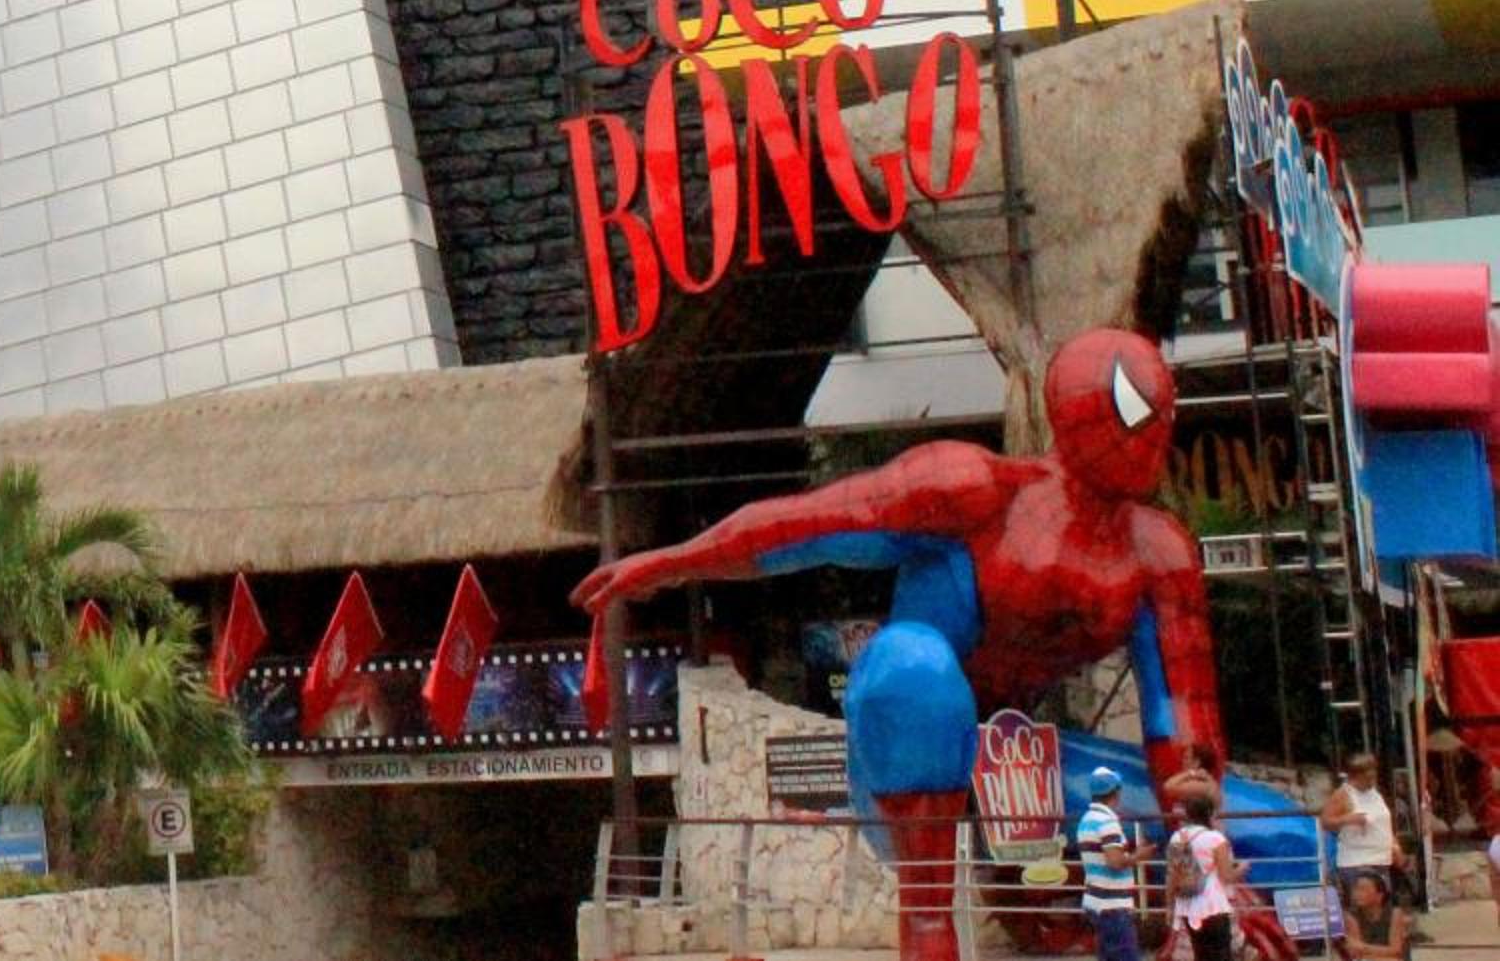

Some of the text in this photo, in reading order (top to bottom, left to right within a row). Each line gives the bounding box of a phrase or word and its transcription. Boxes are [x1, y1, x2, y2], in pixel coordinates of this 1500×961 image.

[560, 32, 982, 353] BONGO
[326, 753, 605, 782] ENTRADA ESTACIONAMIENTO
[161, 809, 178, 831] E
